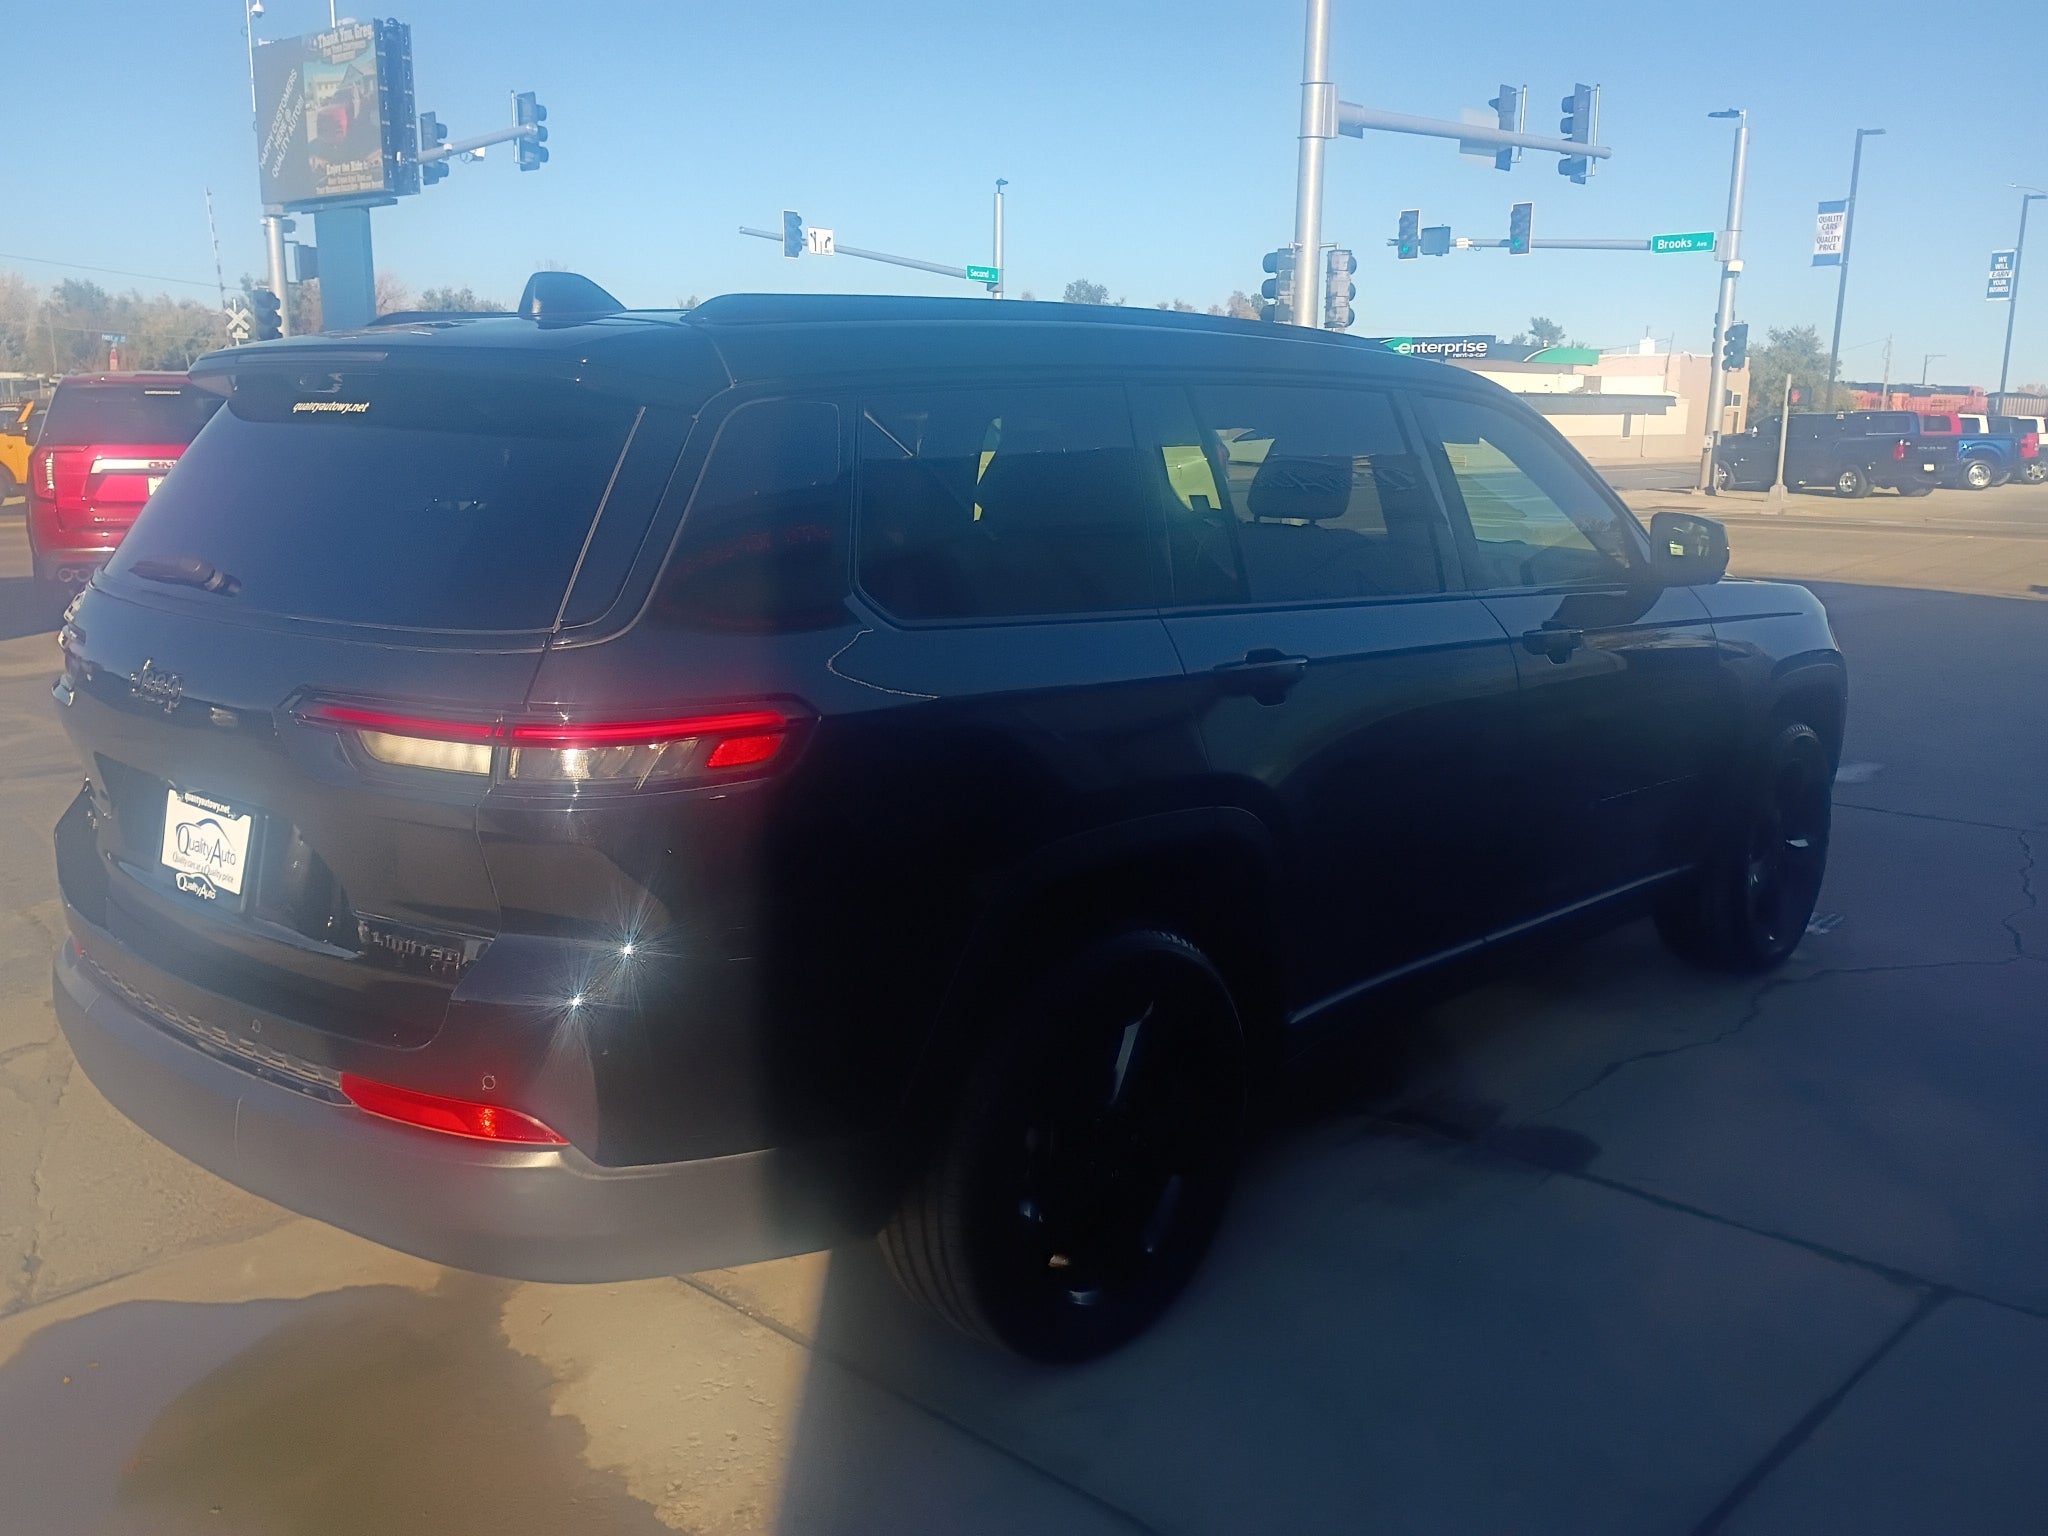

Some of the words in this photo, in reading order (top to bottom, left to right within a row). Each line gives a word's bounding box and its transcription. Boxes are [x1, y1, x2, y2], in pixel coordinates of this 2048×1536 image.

[260, 131, 274, 169] HAPPY
[271, 68, 298, 133] CUSTOMERS
[274, 120, 287, 150] HERE
[271, 136, 290, 178] QUALITY
[1818, 214, 1844, 224] QUALITY
[1821, 223, 1838, 231] CARS
[1657, 238, 1692, 250] Brooks
[1816, 235, 1841, 244] QUALITY
[1819, 243, 1836, 251] PRICE
[1393, 340, 1488, 356] enterprise
